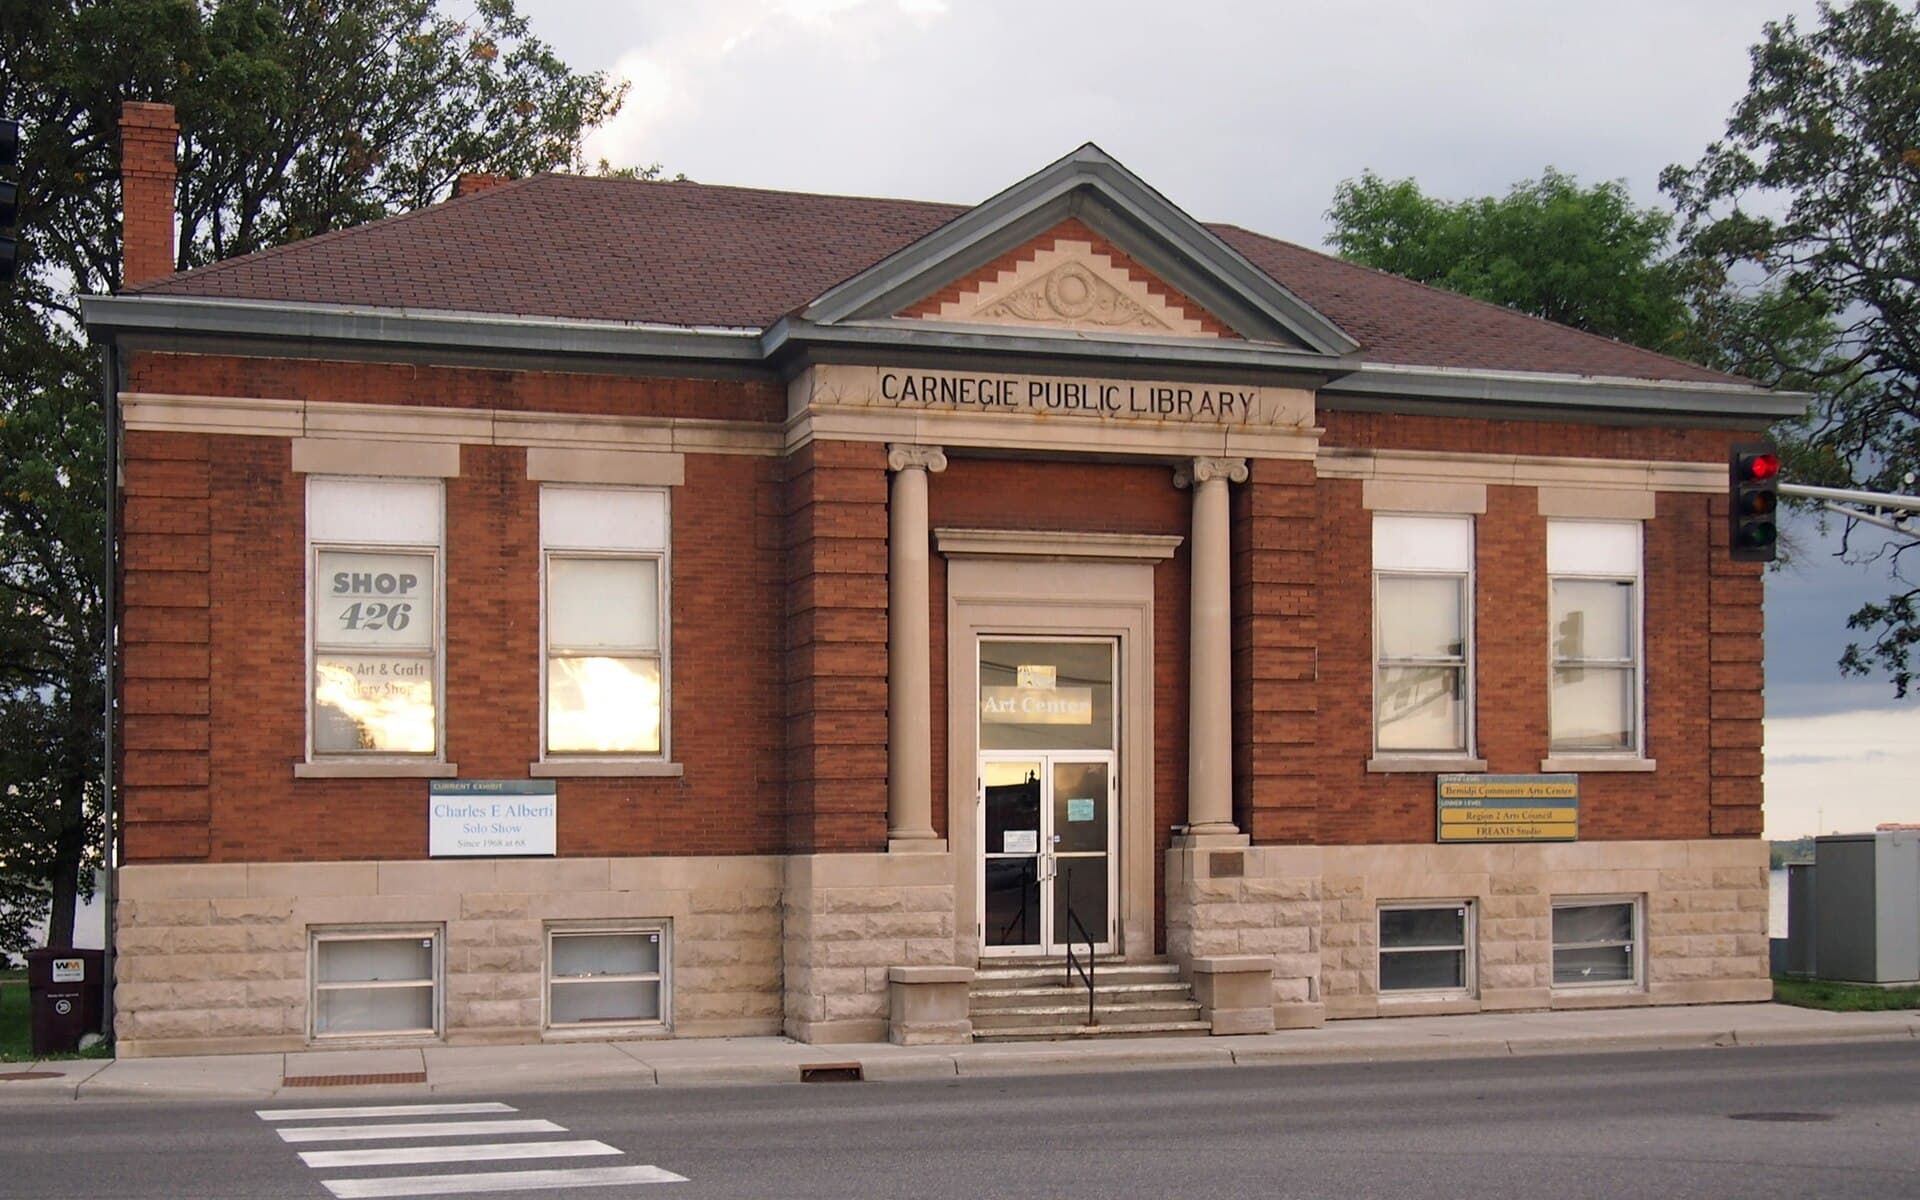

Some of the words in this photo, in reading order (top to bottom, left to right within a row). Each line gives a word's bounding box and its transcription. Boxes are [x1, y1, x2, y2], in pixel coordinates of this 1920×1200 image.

[881, 373, 1018, 407] CARNEGIE
[1028, 381, 1122, 411] PUBLIC
[1130, 386, 1254, 416] LIBRARY
[333, 572, 418, 594] SHOP
[339, 602, 412, 631] 426
[357, 663, 375, 676] Art
[379, 663, 388, 676] &
[393, 663, 424, 676] Craft
[984, 696, 1016, 713] Art
[1021, 696, 1089, 713] Center
[434, 804, 486, 818] Charles
[504, 803, 553, 818] Alberti
[1466, 812, 1493, 821] Region
[1503, 811, 1520, 820] Arts
[1521, 811, 1553, 820] Council
[463, 823, 487, 834] Solo
[490, 823, 521, 834] Show
